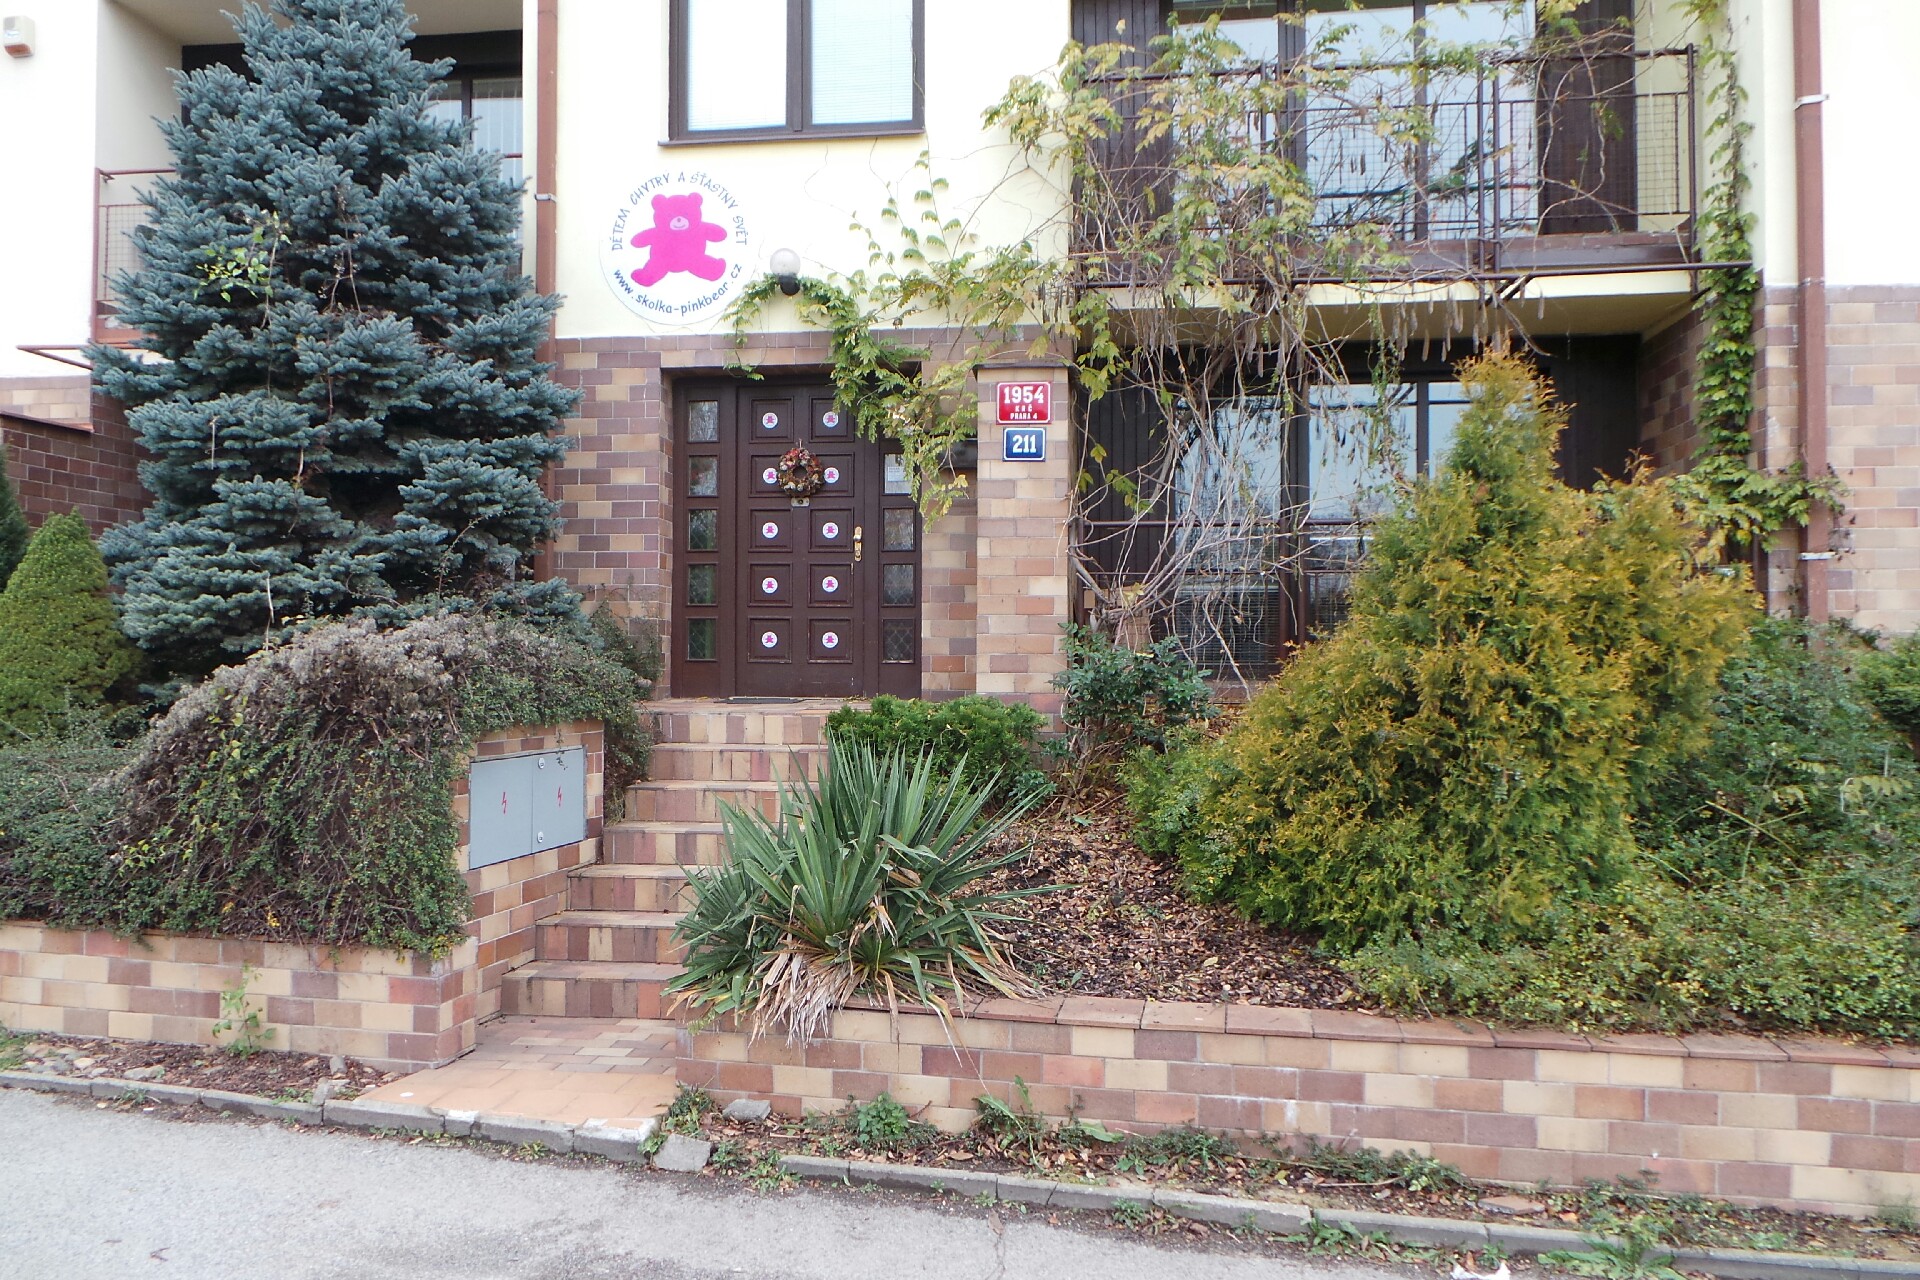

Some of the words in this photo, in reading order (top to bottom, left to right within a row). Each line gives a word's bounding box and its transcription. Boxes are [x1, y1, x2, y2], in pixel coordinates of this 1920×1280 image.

[677, 171, 685, 182] A
[613, 263, 743, 316] www.skolka-pinkbear.cz
[1003, 385, 1044, 404] 1954
[1010, 412, 1031, 420] PRAHA
[1032, 412, 1038, 420] 4
[1012, 434, 1037, 454] 211
